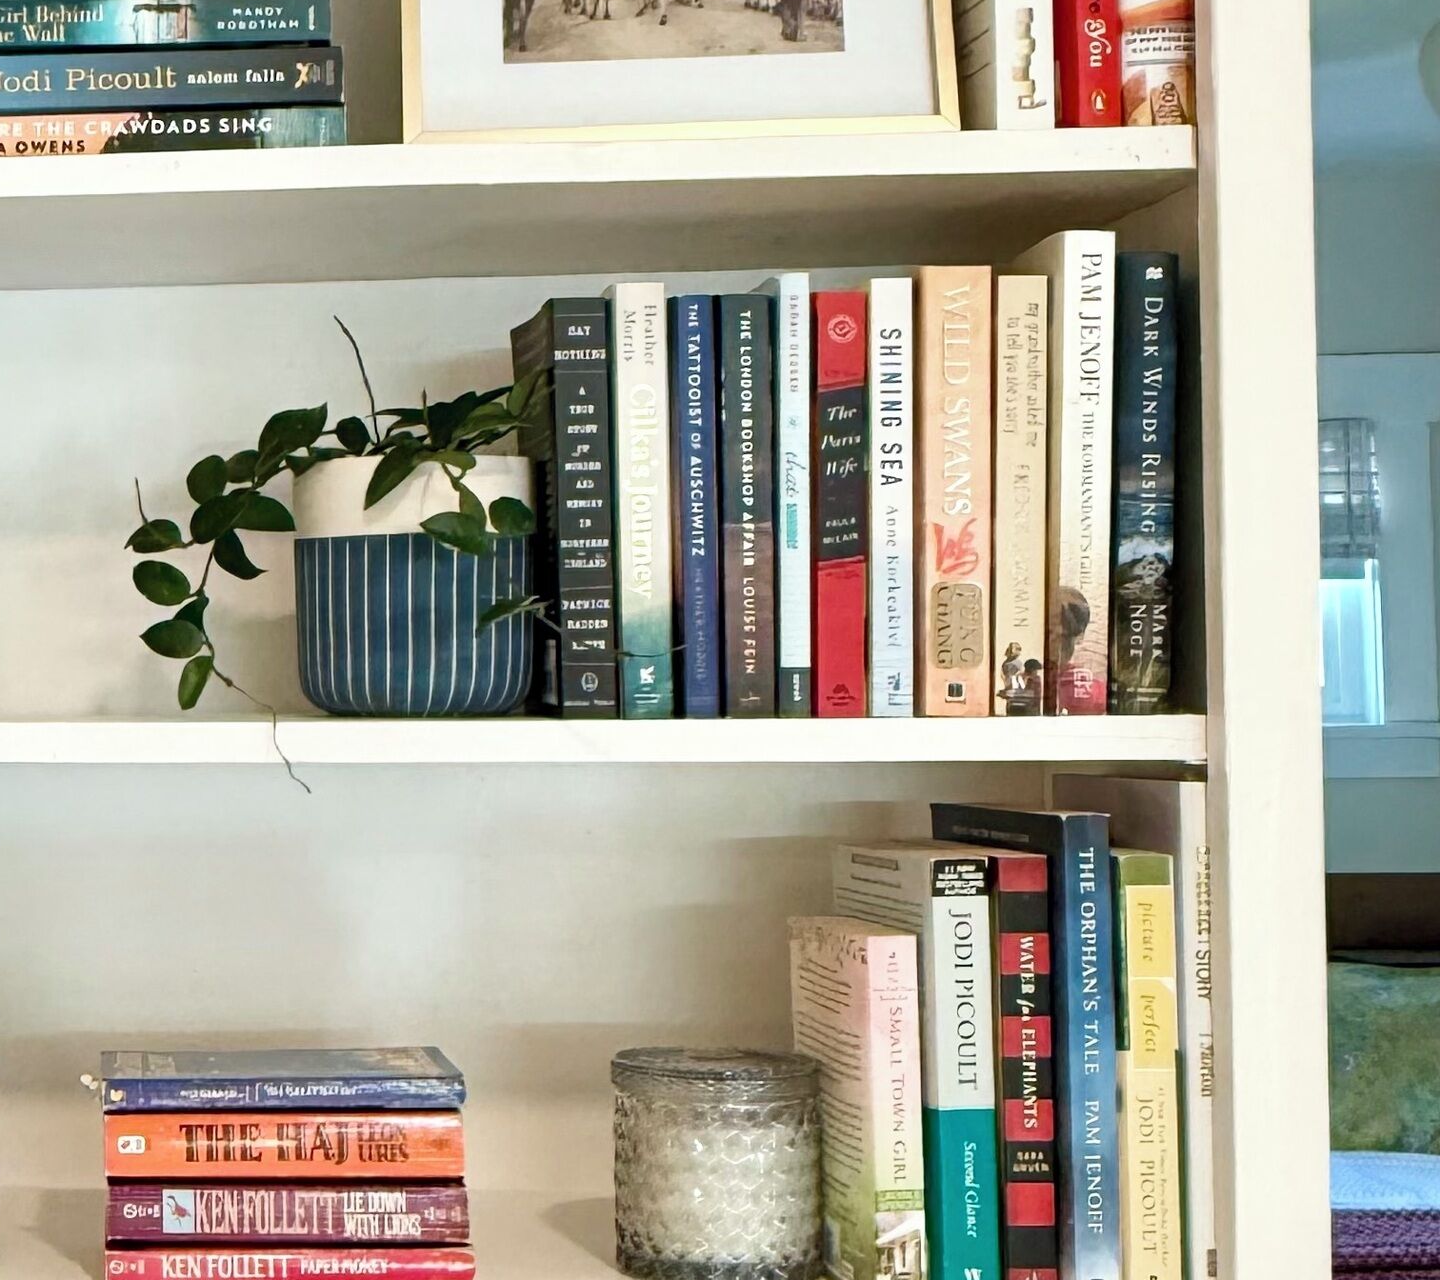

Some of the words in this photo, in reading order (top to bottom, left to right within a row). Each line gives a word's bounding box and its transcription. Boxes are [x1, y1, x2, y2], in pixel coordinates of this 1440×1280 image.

[22, 23, 65, 42] Wall
[37, 4, 104, 22] Behind
[217, 19, 300, 30] ROBOTHAM
[233, 7, 283, 16] MANDY
[1084, 18, 1111, 68] You
[65, 66, 176, 91] Picoult
[188, 71, 238, 84] salem
[245, 68, 285, 83] falls
[15, 140, 85, 153] OWENS
[32, 119, 75, 137] THE
[84, 113, 210, 136] CRAWDADS
[218, 117, 272, 133] SING
[1081, 253, 1102, 303] PAM
[624, 310, 636, 362] Morris
[644, 305, 657, 366] Heather
[689, 304, 697, 326] THE
[740, 310, 752, 340] THE
[941, 282, 971, 386] WILD
[1143, 298, 1163, 357] DARK
[688, 334, 702, 425] TATTOOIST
[740, 346, 752, 412] LONDON
[880, 328, 902, 428] SHINING
[1079, 312, 1101, 407] JENOFF
[1142, 367, 1163, 443] WINDS
[691, 433, 700, 450] OF
[741, 419, 754, 506] BOOKSHOP
[880, 443, 902, 486] SEA
[942, 397, 971, 516] SWANS
[690, 456, 704, 557] AUSCHWITZ
[1141, 454, 1161, 533] RISING
[742, 512, 755, 565] AFFAIR
[743, 577, 755, 632] LOUISE
[744, 639, 756, 674] FEIN
[1079, 848, 1095, 894] THE
[950, 910, 973, 968] JODI
[1081, 902, 1099, 1011] ORPHAN'S
[1138, 902, 1156, 962] picture
[889, 1006, 904, 1067] SMALL
[955, 979, 978, 1090] PICOULT
[1084, 1020, 1100, 1074] TALE
[1140, 994, 1158, 1053] perfect
[892, 1075, 906, 1132] TOWN
[1084, 1101, 1100, 1144] PAM
[1137, 1096, 1154, 1144] JODI
[179, 1123, 261, 1162] THE
[276, 1121, 349, 1165] HAJ
[892, 1141, 907, 1184] GIRL
[196, 1190, 239, 1234] KEN
[244, 1190, 338, 1234] FOLLETT
[1085, 1155, 1104, 1234] JENOFF
[1140, 1160, 1158, 1255] PICOULT
[162, 1256, 200, 1279] KEN
[208, 1254, 288, 1278] FOLLETT
